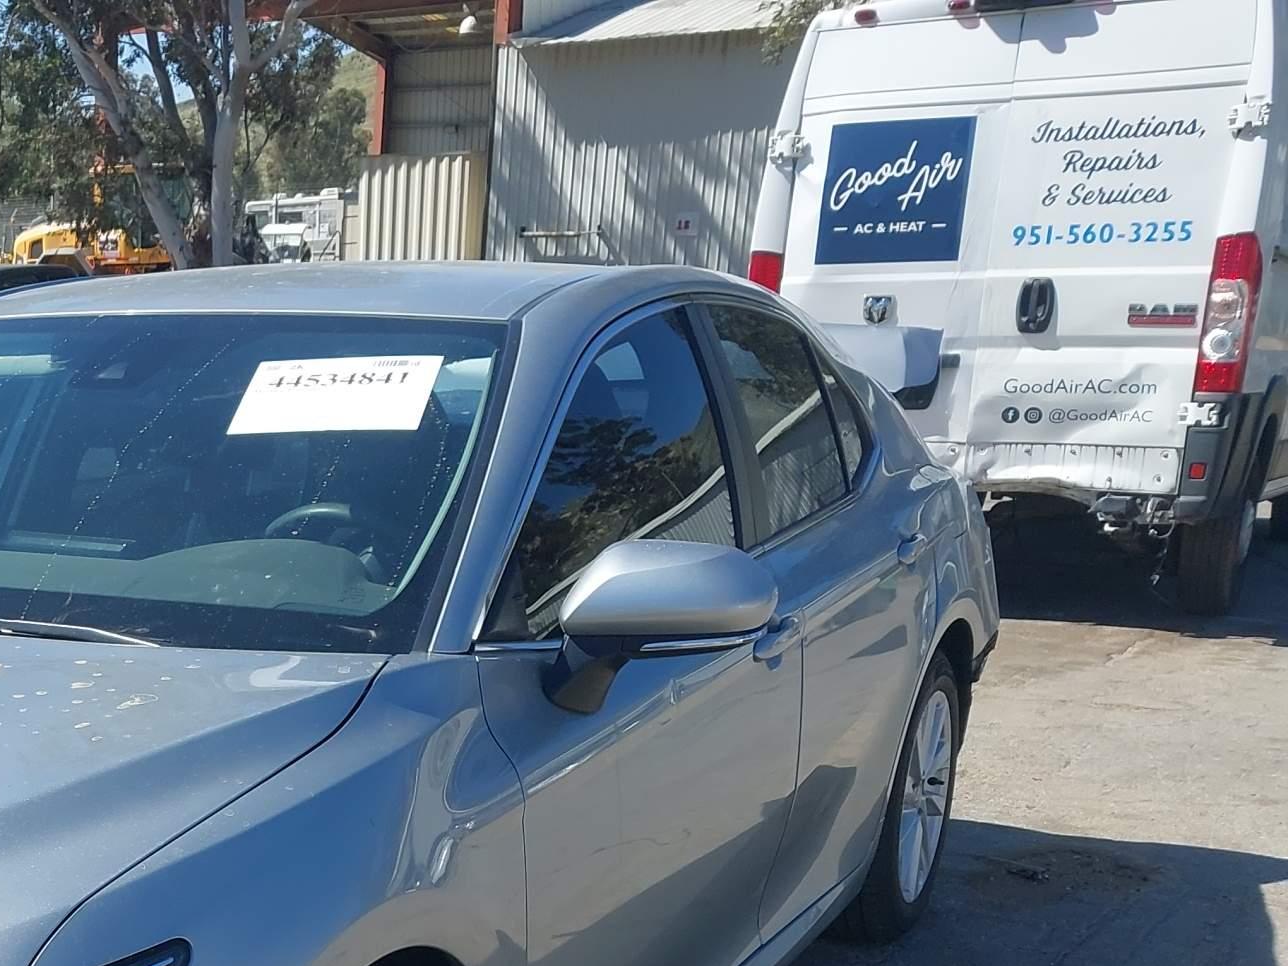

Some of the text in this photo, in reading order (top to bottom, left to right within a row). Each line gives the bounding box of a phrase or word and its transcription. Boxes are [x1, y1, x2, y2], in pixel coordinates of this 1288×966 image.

[1031, 115, 1206, 144] Installations,
[829, 139, 964, 212] Good Air
[1062, 148, 1164, 180] Repairs
[1041, 182, 1173, 207] & Services
[853, 221, 927, 235] AC & HEAT
[1012, 220, 1194, 247] 951-560-3255
[268, 371, 409, 388] 44534841
[1003, 378, 1158, 395] GoodAirAC.com
[1048, 408, 1154, 425] @GoodAirAC
